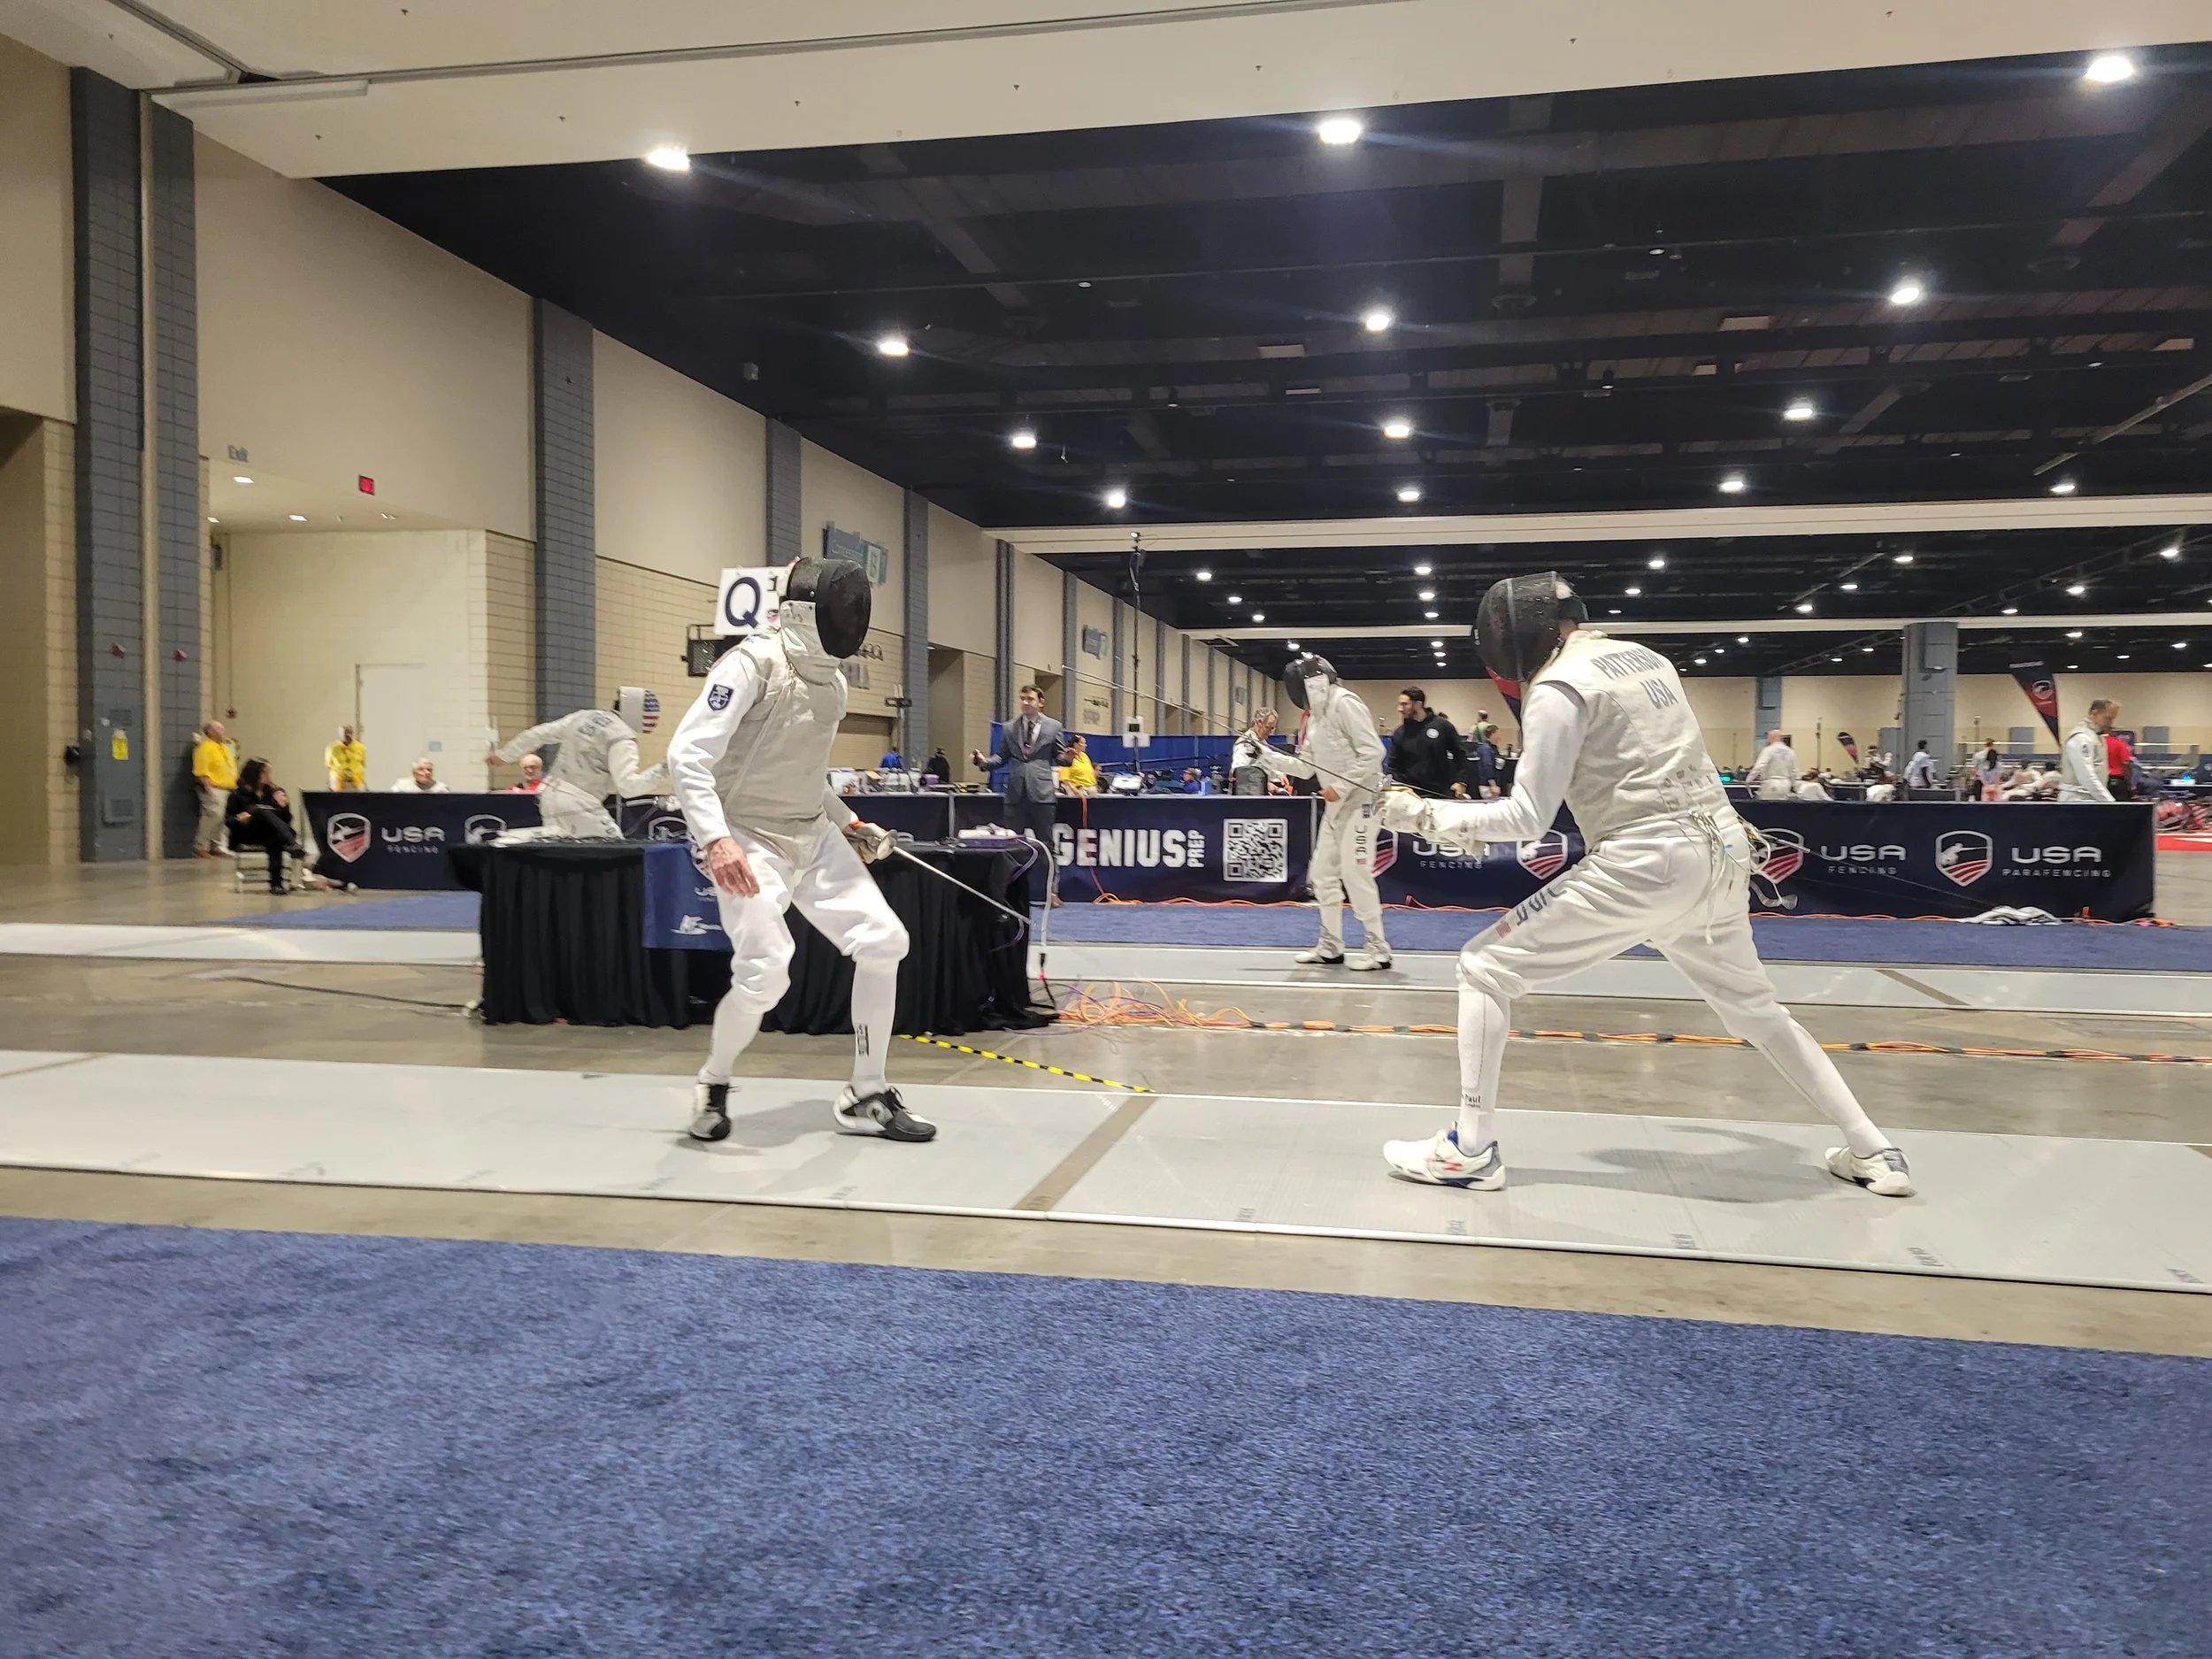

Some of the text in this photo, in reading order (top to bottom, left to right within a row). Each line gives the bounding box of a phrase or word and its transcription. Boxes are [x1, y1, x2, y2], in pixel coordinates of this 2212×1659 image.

[726, 576, 761, 629] Q
[1590, 647, 1664, 680] PATTERSON
[1639, 678, 1678, 709] USA
[381, 826, 445, 842] USA
[1052, 823, 1187, 868] GENIUS
[1187, 829, 1206, 868] PREP
[1820, 844, 1907, 861] USA
[2011, 846, 2102, 864] USA
[1420, 860, 1483, 870] FENCING
[1828, 865, 1898, 875] FENCING
[2001, 868, 2112, 878] PARAFENCING
